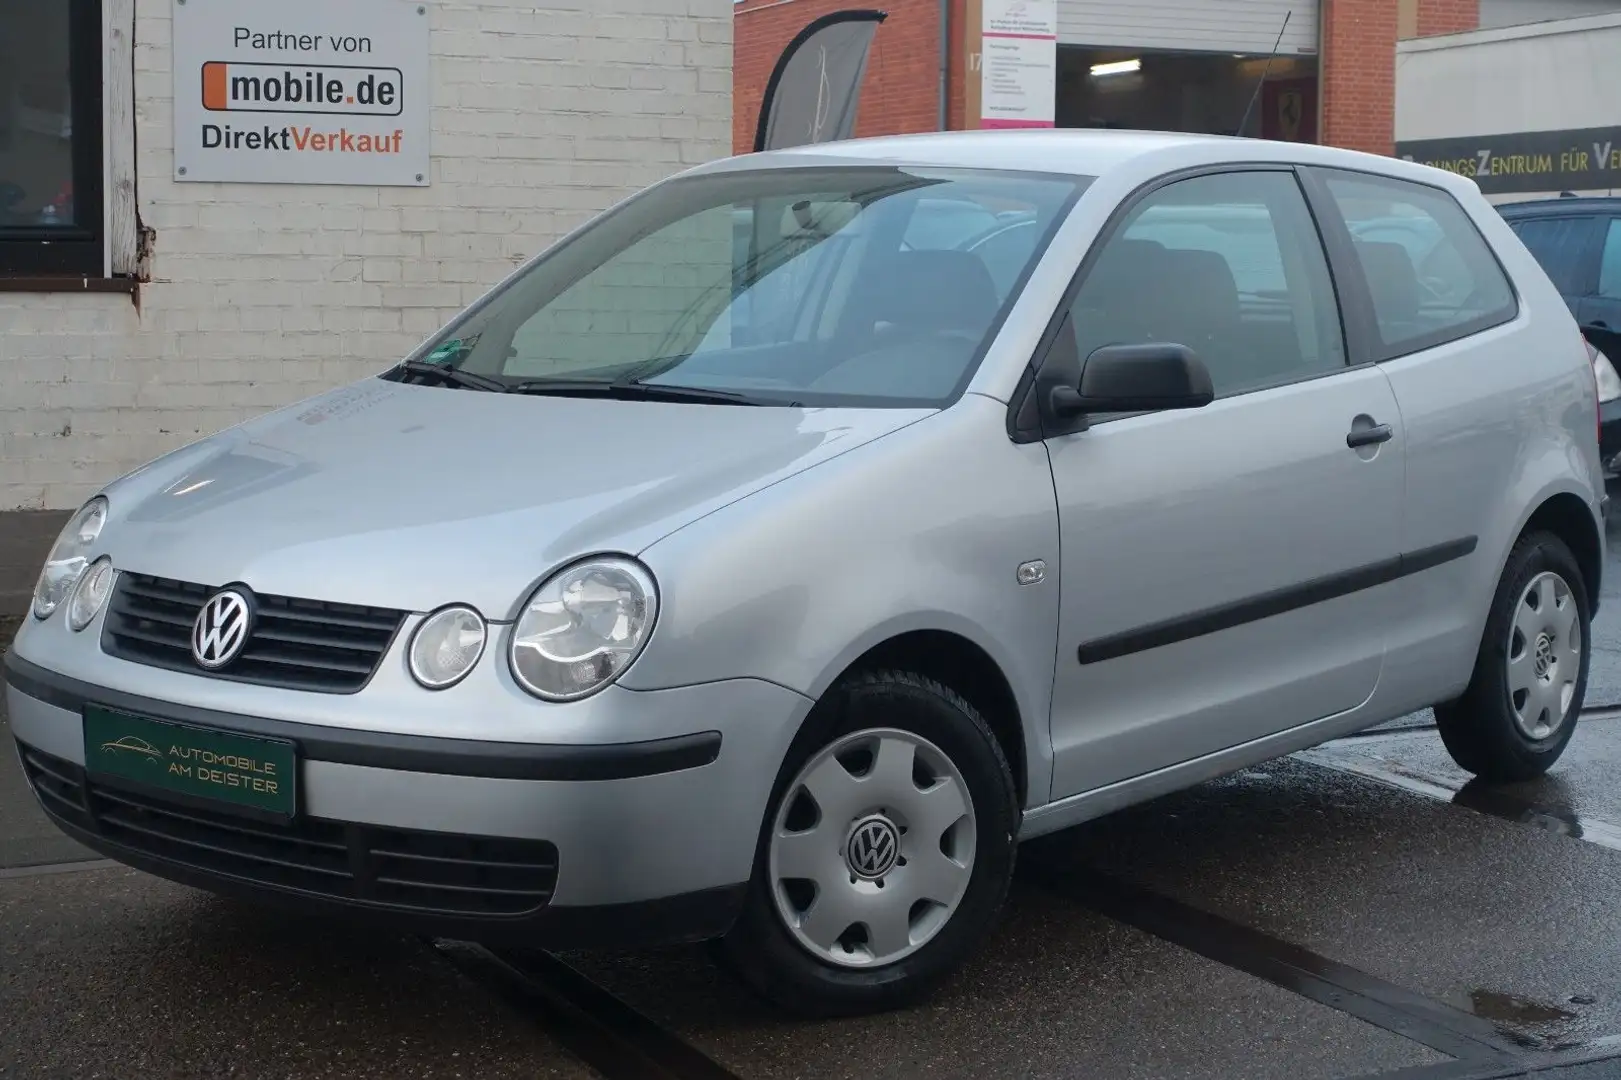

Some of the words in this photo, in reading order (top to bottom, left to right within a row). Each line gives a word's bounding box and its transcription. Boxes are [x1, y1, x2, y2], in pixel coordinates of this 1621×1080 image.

[234, 27, 322, 50] Partner
[330, 36, 371, 52] von
[231, 71, 395, 105] mobile.de
[202, 124, 403, 153] DirektVerkauf
[1560, 147, 1588, 172] FÜR
[169, 745, 276, 775] AUTOMOBILE
[168, 762, 192, 777] AM
[198, 767, 278, 794] DEISTER
